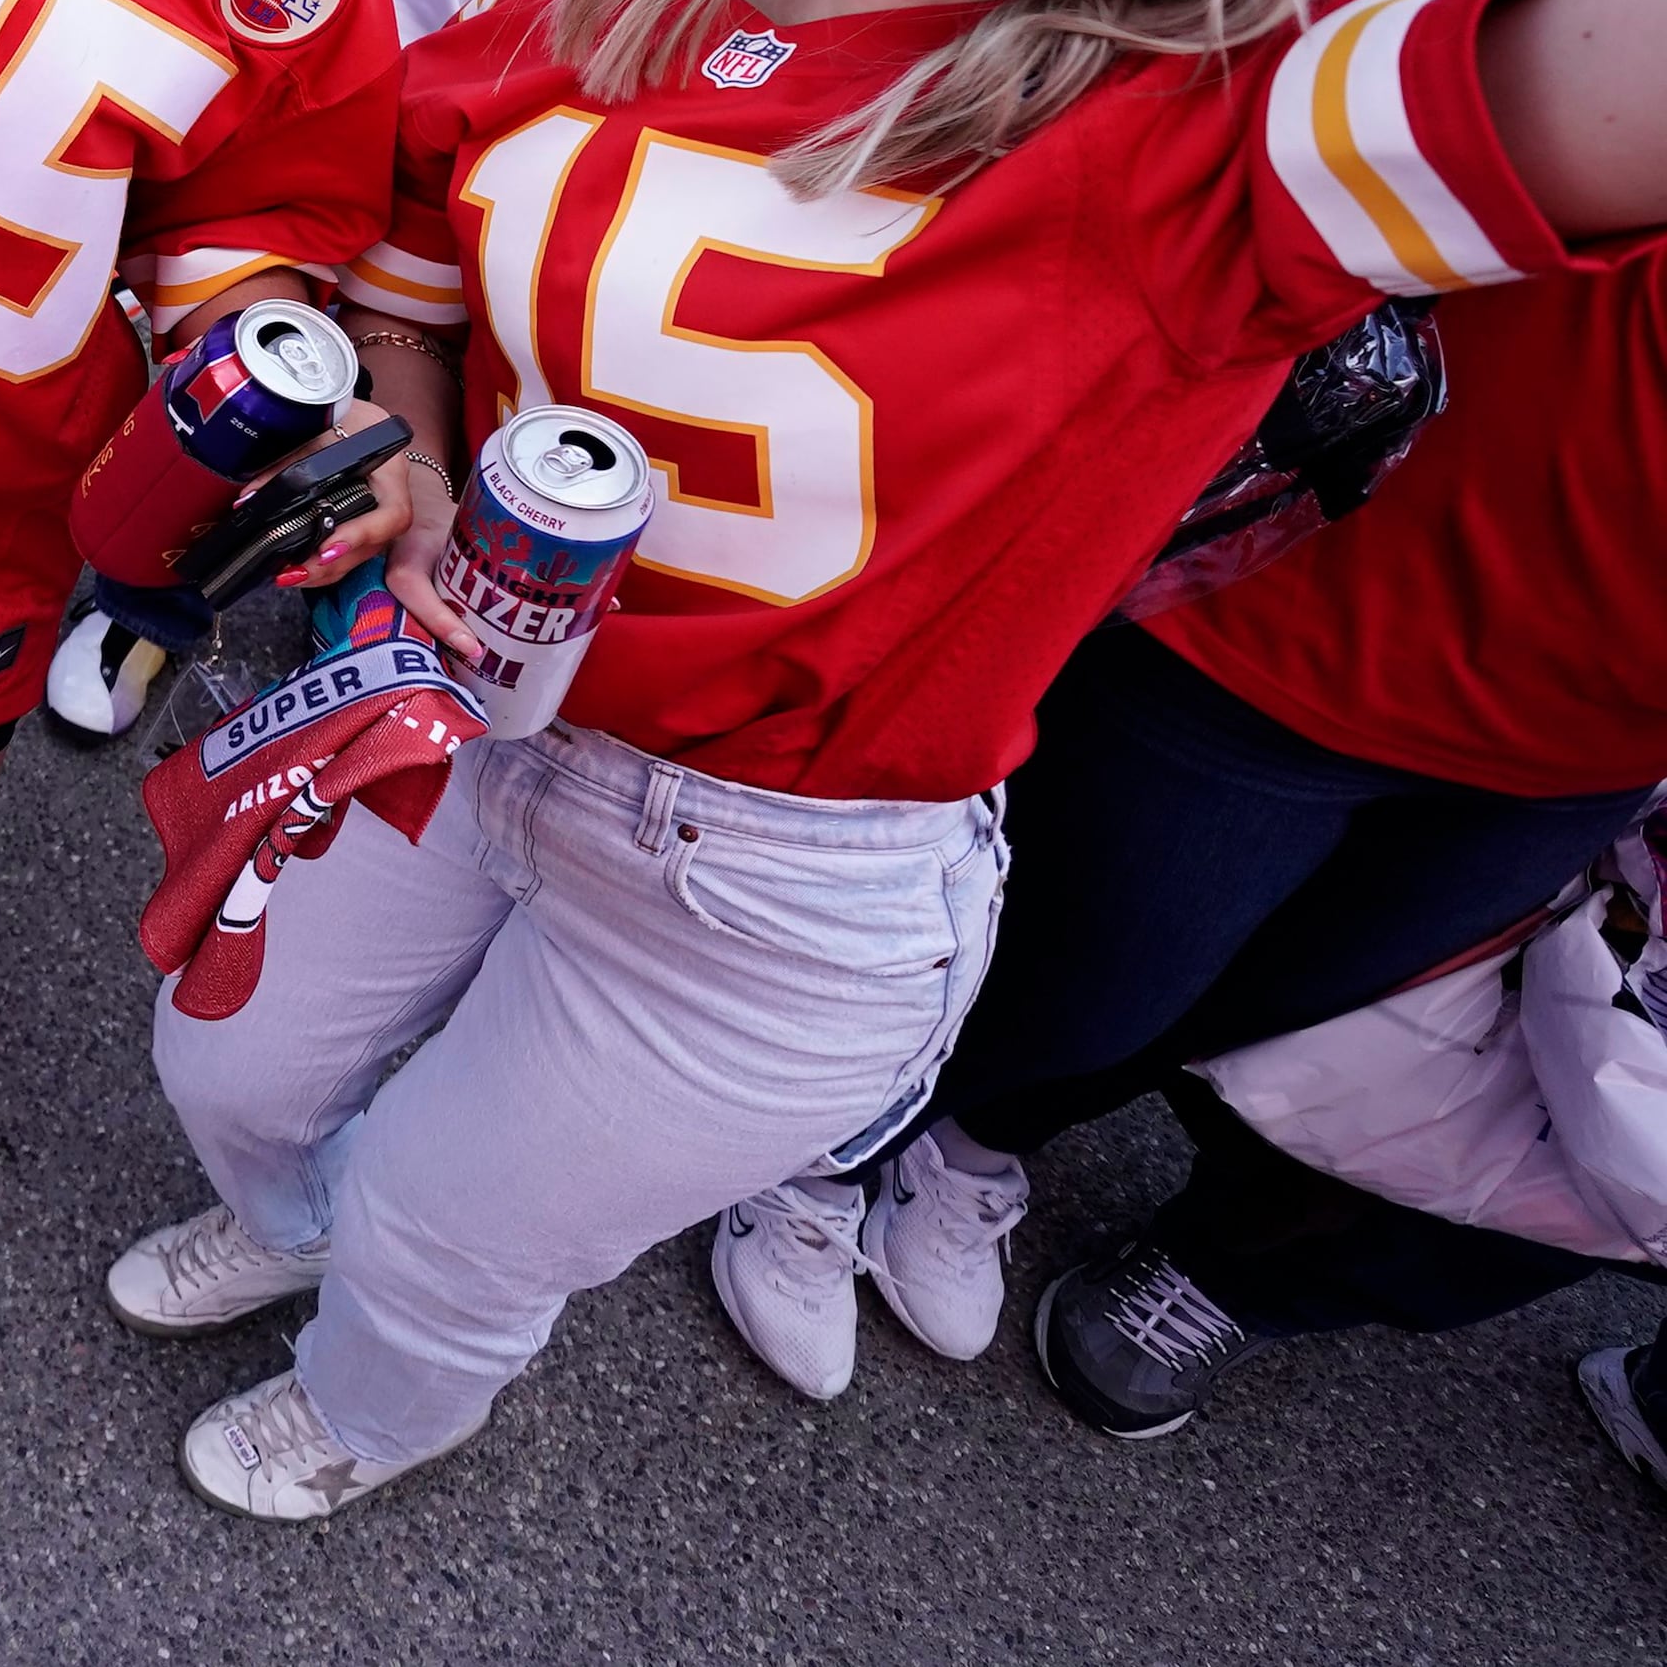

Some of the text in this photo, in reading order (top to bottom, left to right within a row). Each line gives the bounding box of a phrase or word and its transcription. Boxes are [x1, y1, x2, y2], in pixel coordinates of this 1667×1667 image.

[707, 45, 793, 86] NFL
[457, 103, 945, 608] 15
[489, 472, 567, 532] BLACK CHERRY
[439, 550, 577, 644] ELTZER
[479, 560, 583, 608] LIGHT
[227, 665, 364, 750] SUPER
[223, 753, 336, 824] ARIZO
